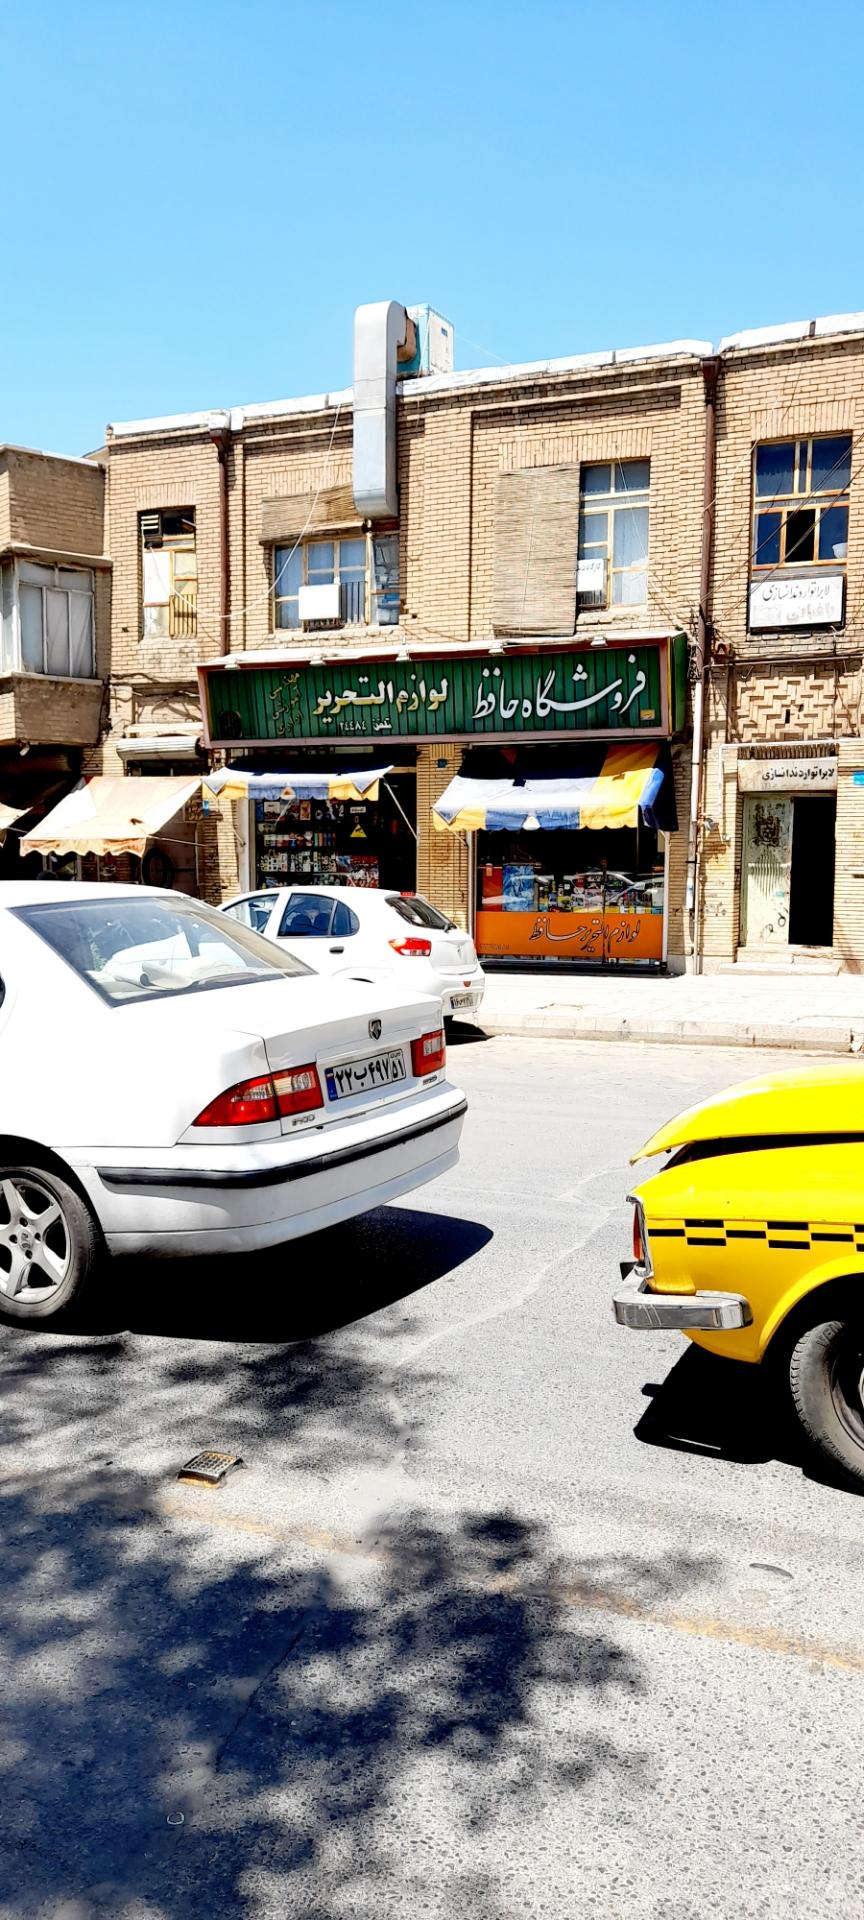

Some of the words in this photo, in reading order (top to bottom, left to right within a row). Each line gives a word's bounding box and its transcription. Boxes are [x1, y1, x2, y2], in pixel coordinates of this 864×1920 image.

[312, 676, 394, 724] التحریر
[396, 673, 449, 714] لوازم
[472, 667, 520, 719] حافظ
[521, 653, 647, 719] فروشگاه
[761, 767, 805, 781] دندانسازی
[803, 766, 836, 781] لابراتوار
